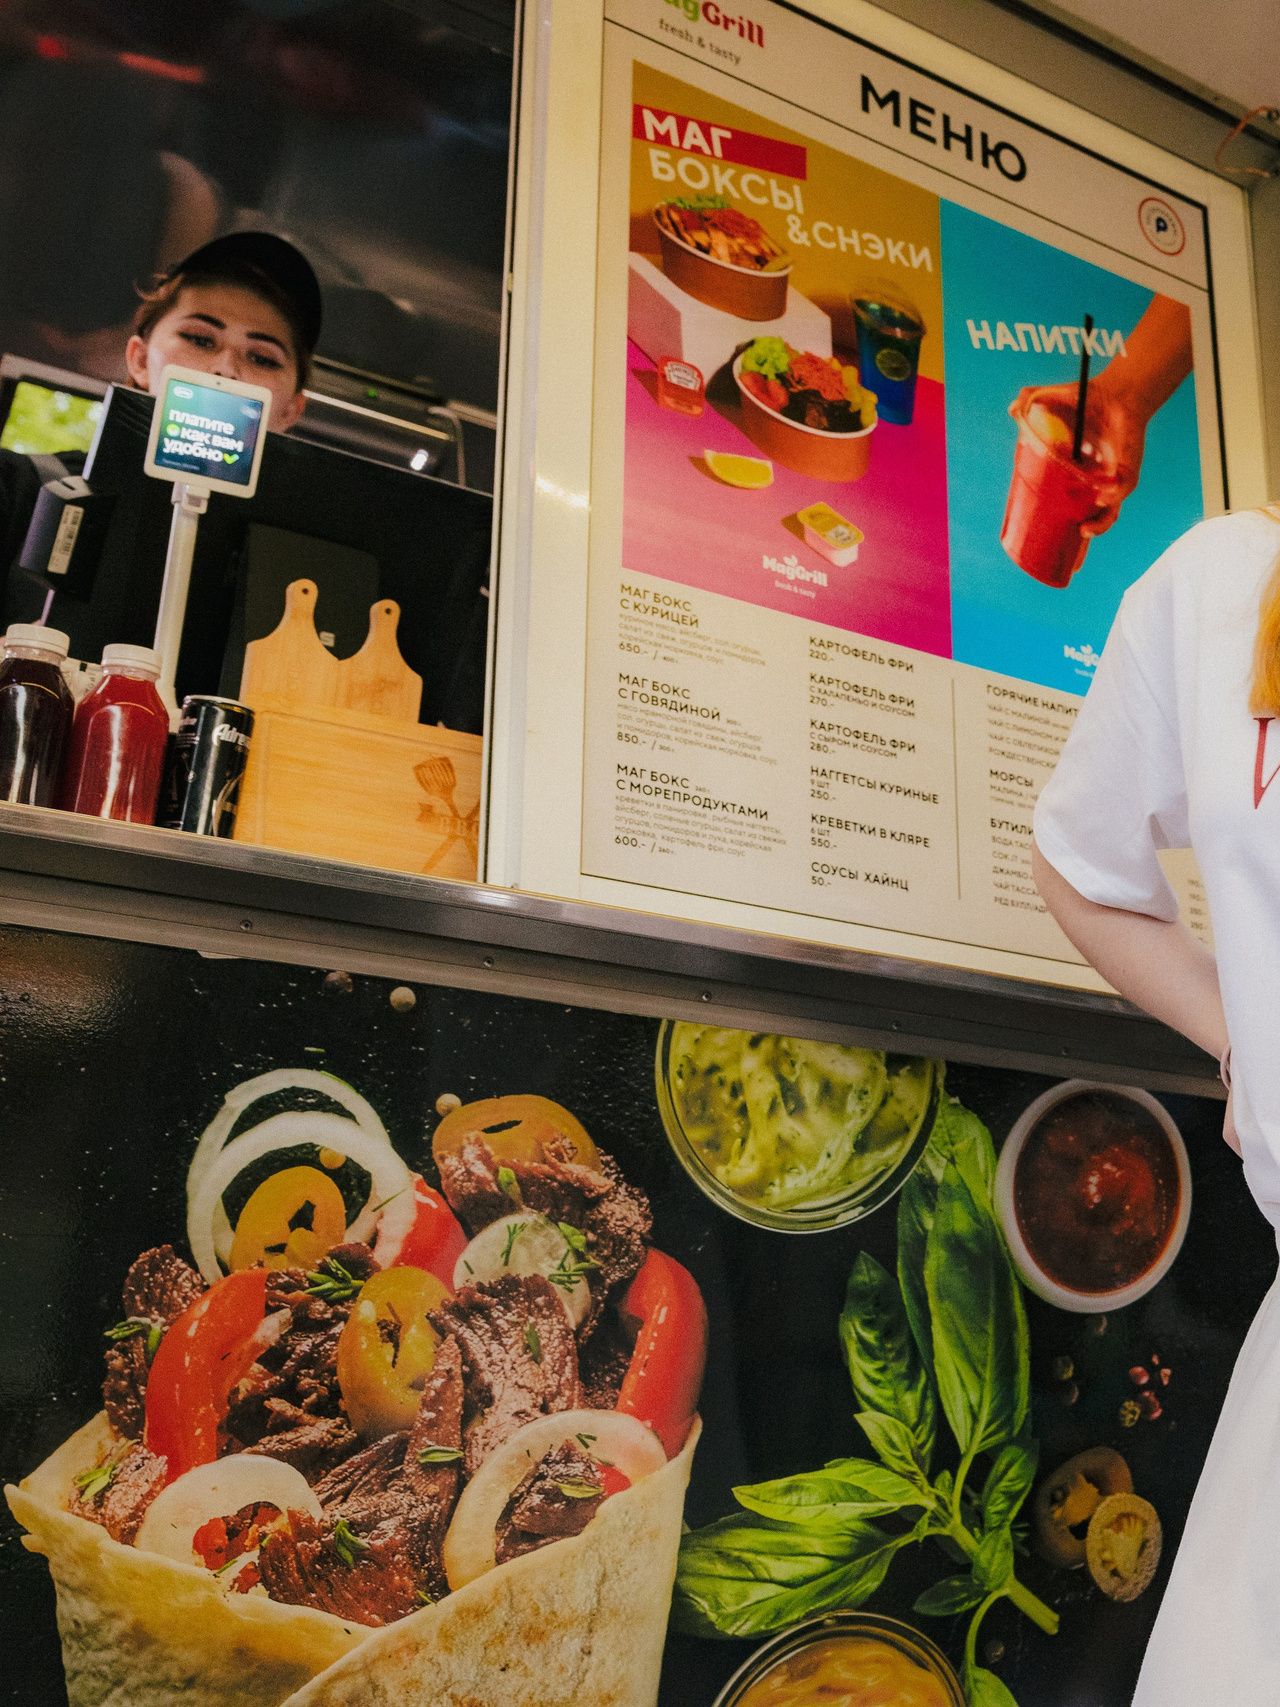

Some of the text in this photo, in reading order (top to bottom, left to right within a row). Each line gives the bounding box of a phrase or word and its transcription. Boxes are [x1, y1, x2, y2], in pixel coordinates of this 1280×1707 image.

[660, 18, 741, 66] fresh & tasty
[642, 108, 732, 159] МАГ
[860, 74, 1027, 183] МЕНЮ
[648, 147, 804, 215] БОКСЫ
[966, 319, 1128, 358] НАПИТКИ
[169, 409, 235, 435] платите
[163, 437, 223, 462] удобно
[180, 427, 244, 452] как вам
[620, 583, 692, 612] МАГ БОКС
[620, 598, 699, 628] С КУРИЦЕЙ
[809, 636, 914, 673] КАРТОФЕЛЬ ФРИ
[619, 673, 691, 700] МАГ БОКС
[810, 672, 915, 708] КАРТОФЕЛЬ ФРИ
[986, 684, 1039, 707] ГОРЯЧИЕ
[618, 688, 720, 721] С ГОВЯДИНОЙ
[810, 719, 916, 753] КАРТОФЕЛЬ ФРИ
[617, 764, 647, 779] МАГ
[650, 770, 690, 789] БОКС
[810, 765, 939, 805] НАГГЕТСЫ КУРИНЫЕ
[989, 769, 1034, 787] МОРСЫ
[616, 779, 626, 791] С
[630, 782, 768, 821] МОРЕПРОДУКТАМИ
[614, 834, 646, 849] 600.-
[811, 813, 930, 848] КРЕВЕТКИ В КЛЯРЕ
[811, 861, 909, 892] СОУСЫ ХАЙНЦ
